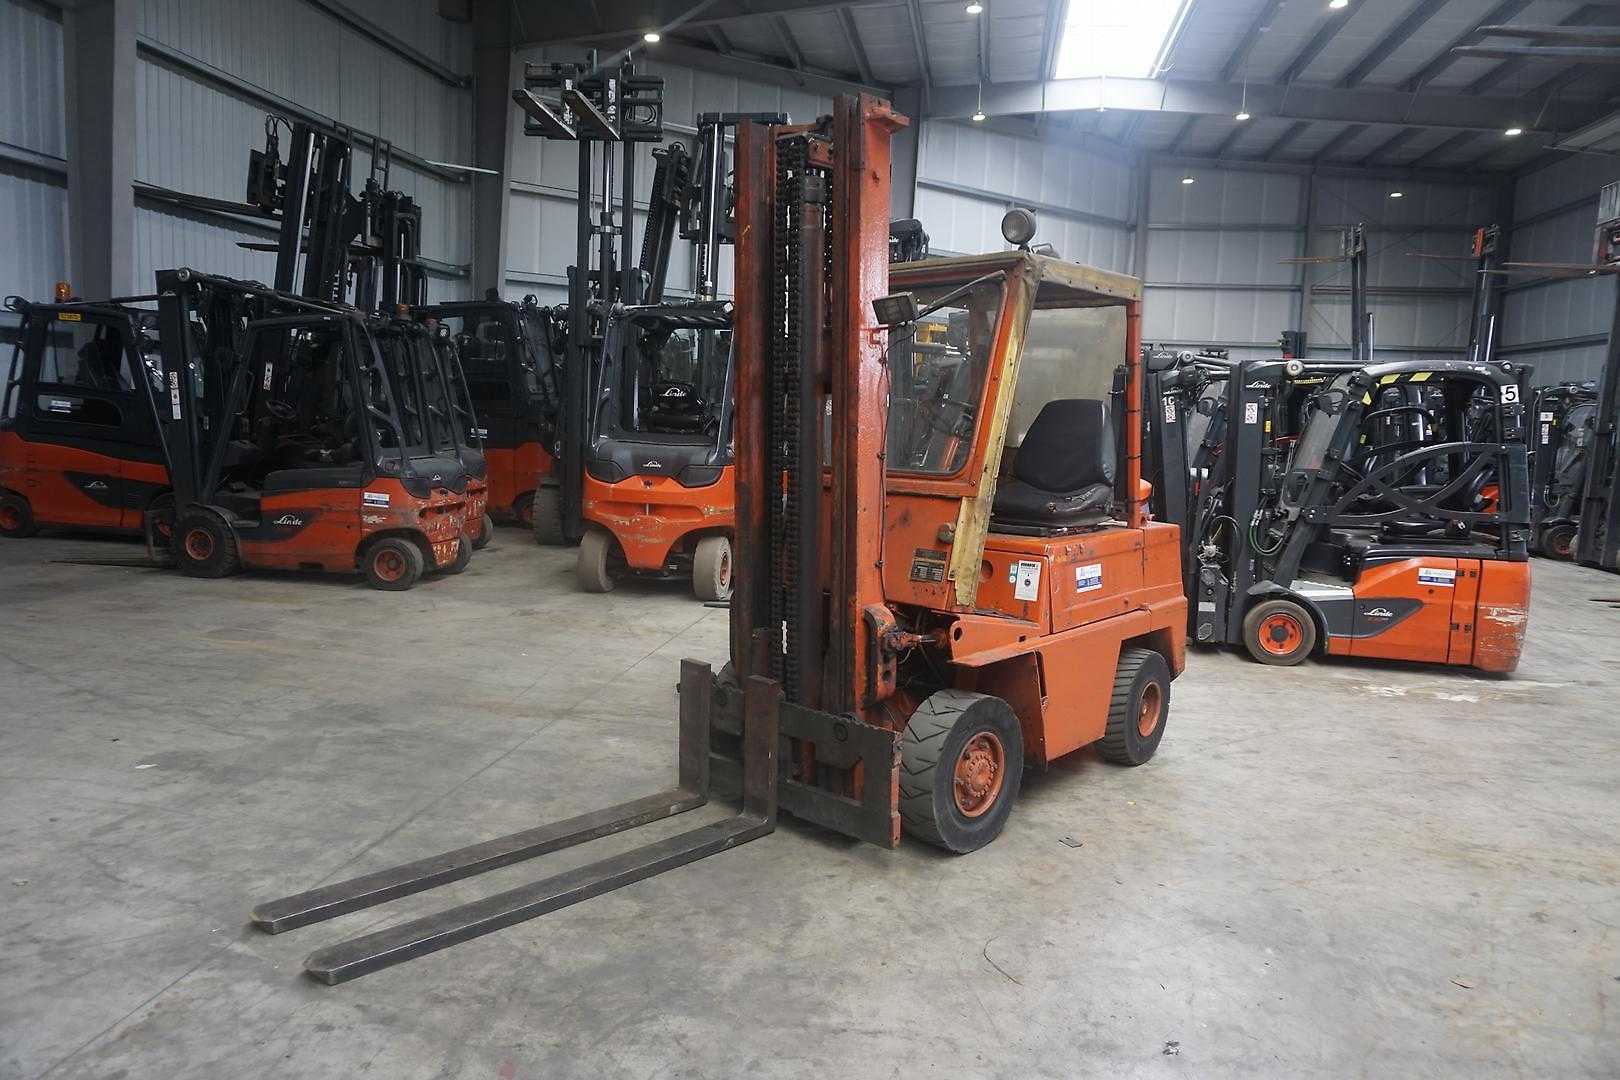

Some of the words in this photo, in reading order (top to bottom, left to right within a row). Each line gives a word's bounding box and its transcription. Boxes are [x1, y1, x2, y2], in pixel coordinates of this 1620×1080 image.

[1246, 380, 1272, 389] Linde
[659, 387, 687, 397] Linde
[1505, 386, 1516, 401] 5
[273, 514, 303, 526] Linde
[1364, 607, 1393, 617] Linde
